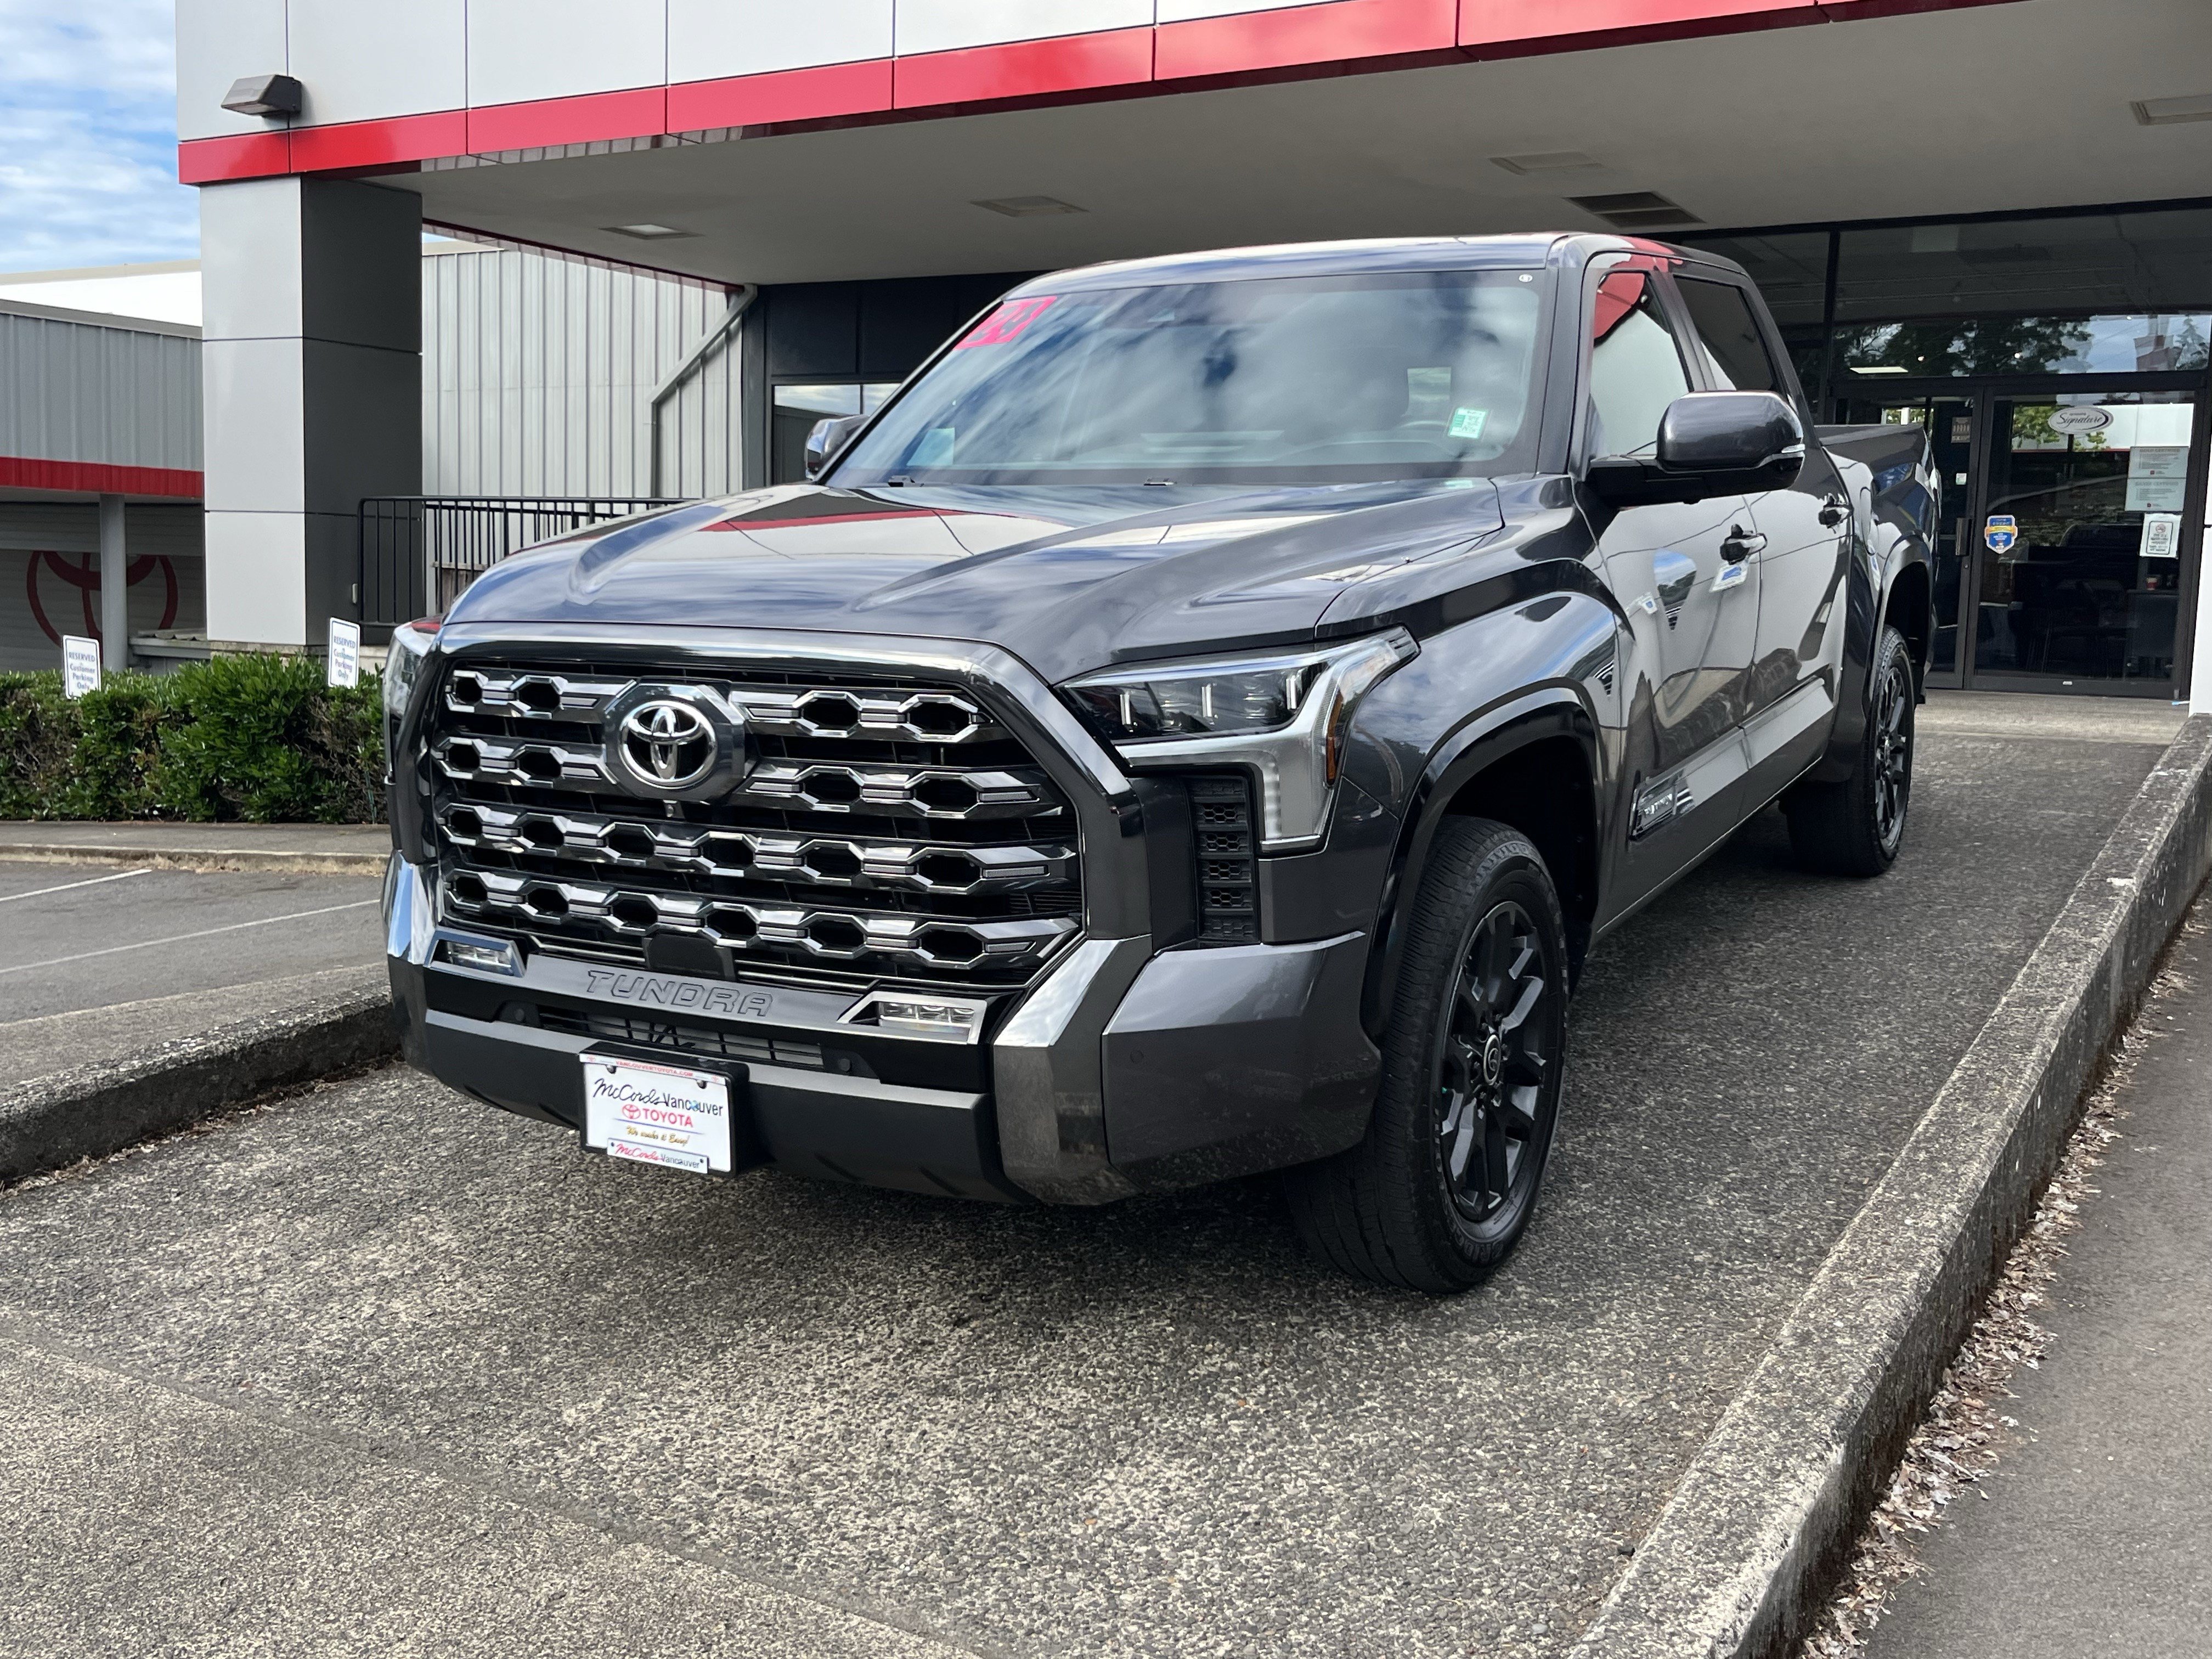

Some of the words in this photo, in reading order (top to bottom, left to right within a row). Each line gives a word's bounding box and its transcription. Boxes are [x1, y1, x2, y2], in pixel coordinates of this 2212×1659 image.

[2057, 413, 2102, 428] Signature
[334, 635, 356, 648] RESERVED
[69, 652, 95, 662] RESERVED
[70, 663, 95, 673] Customer
[72, 672, 93, 684] Parking
[586, 970, 774, 1017] TUNDRA
[642, 1108, 693, 1127] TOYOTA
